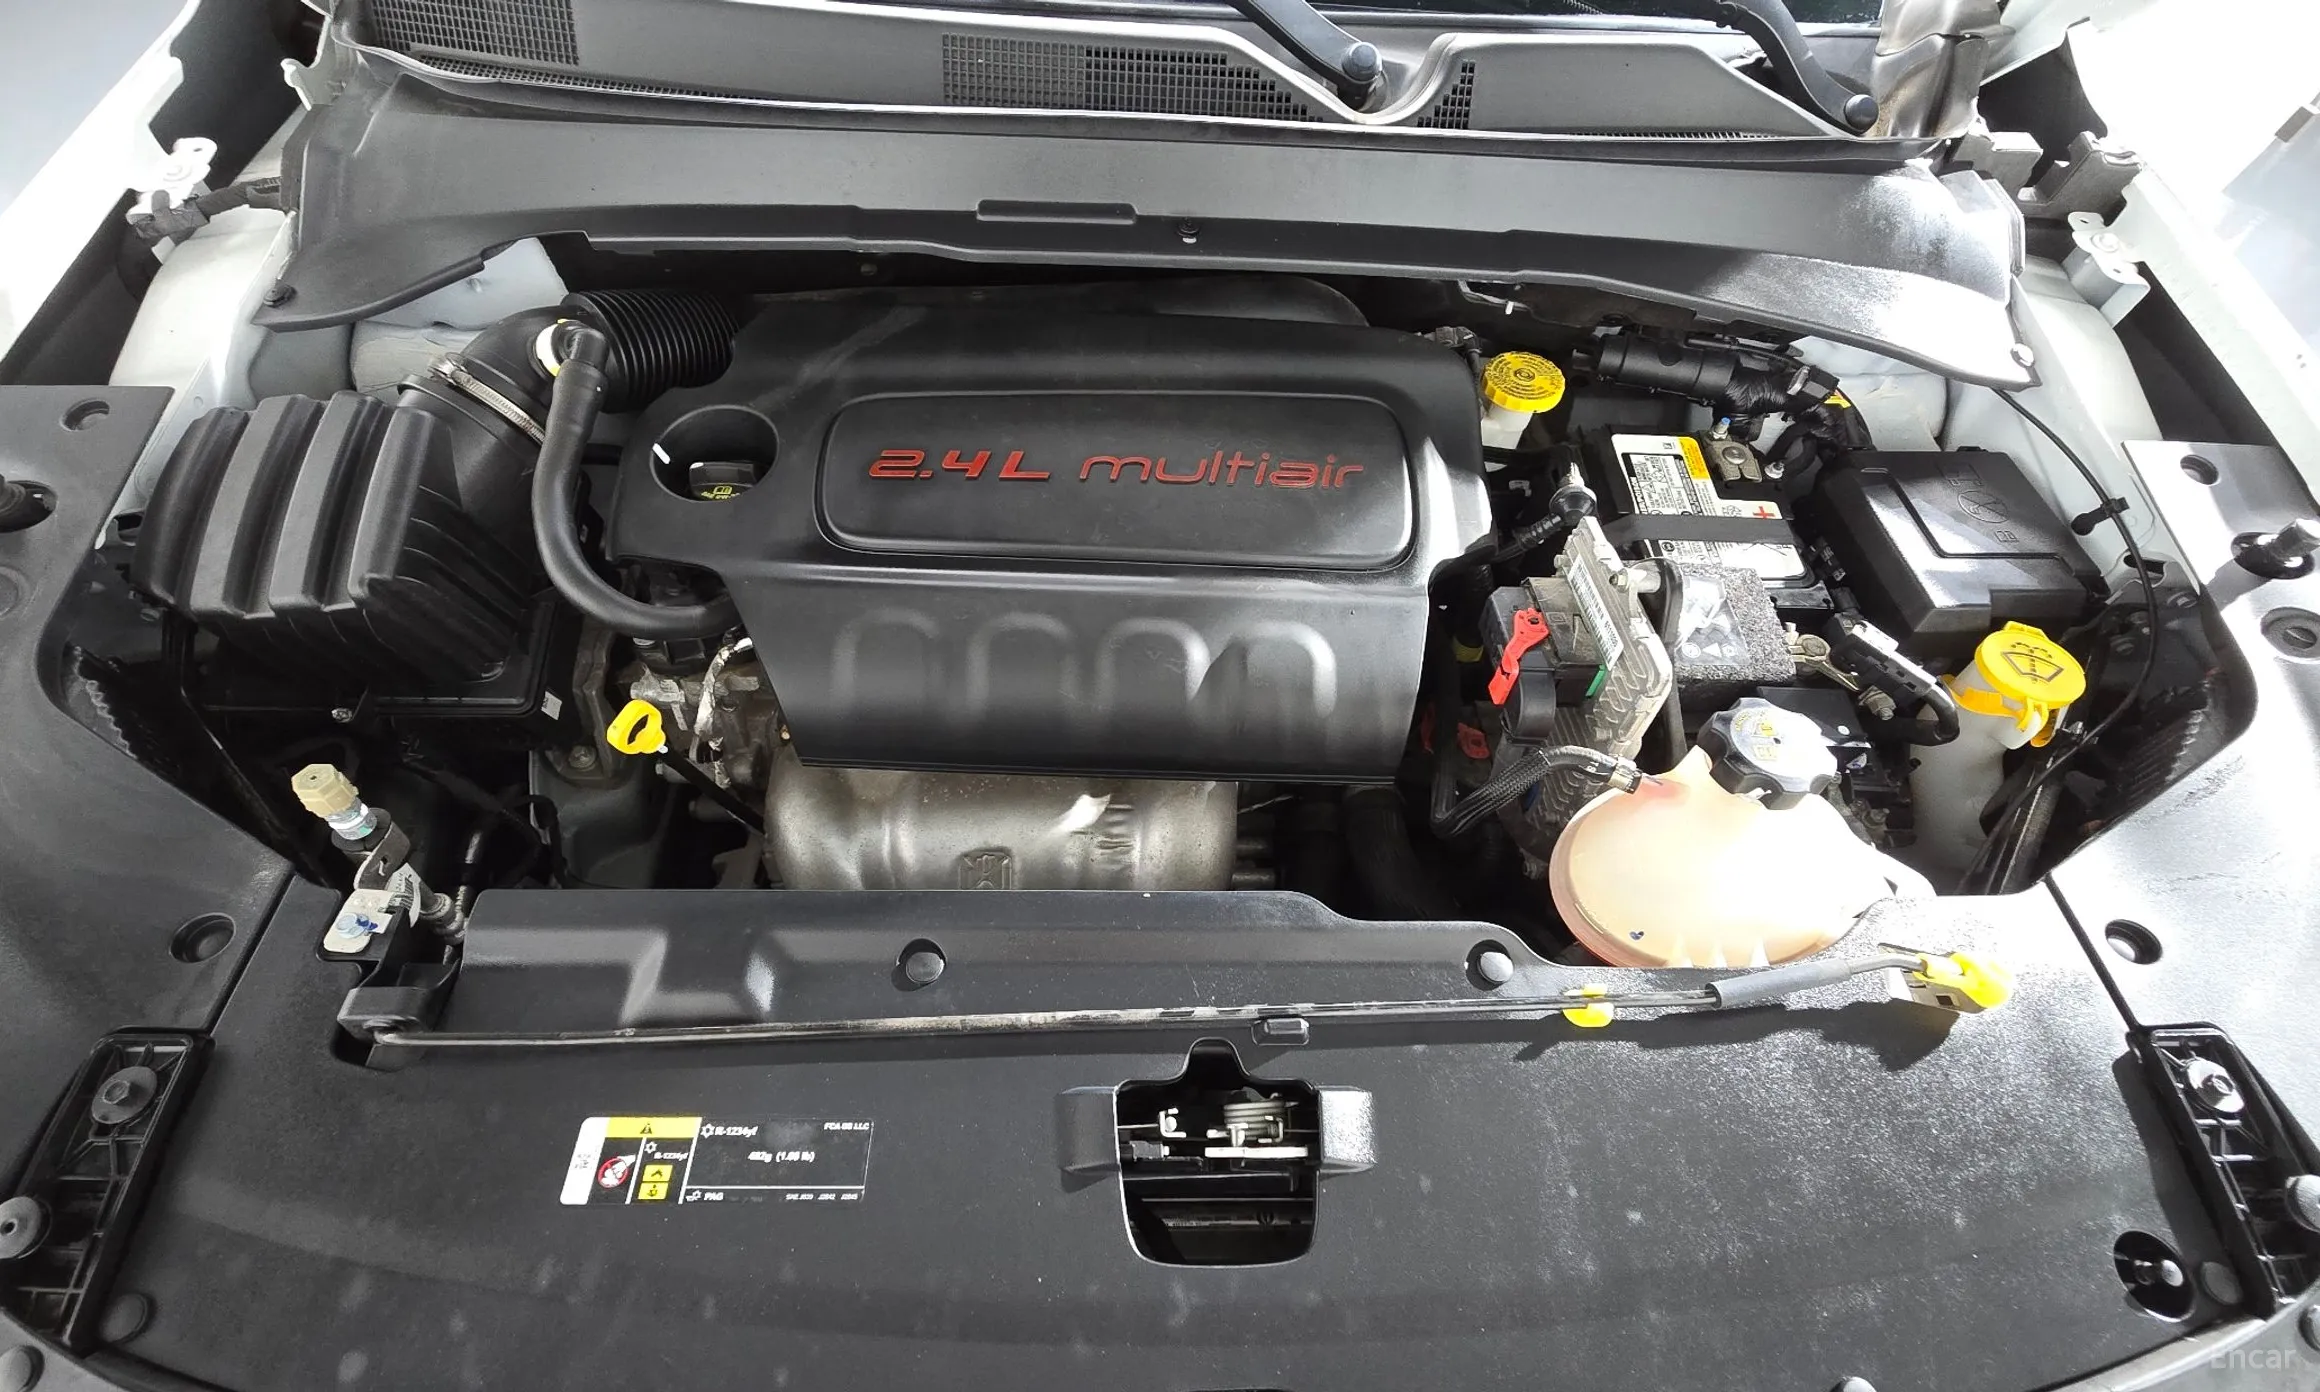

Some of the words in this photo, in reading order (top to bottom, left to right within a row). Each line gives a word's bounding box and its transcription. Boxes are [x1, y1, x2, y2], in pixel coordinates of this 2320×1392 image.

[868, 449, 1050, 481] 2.4L
[1079, 449, 1364, 488] multiair
[704, 1192, 724, 1201] PAG
